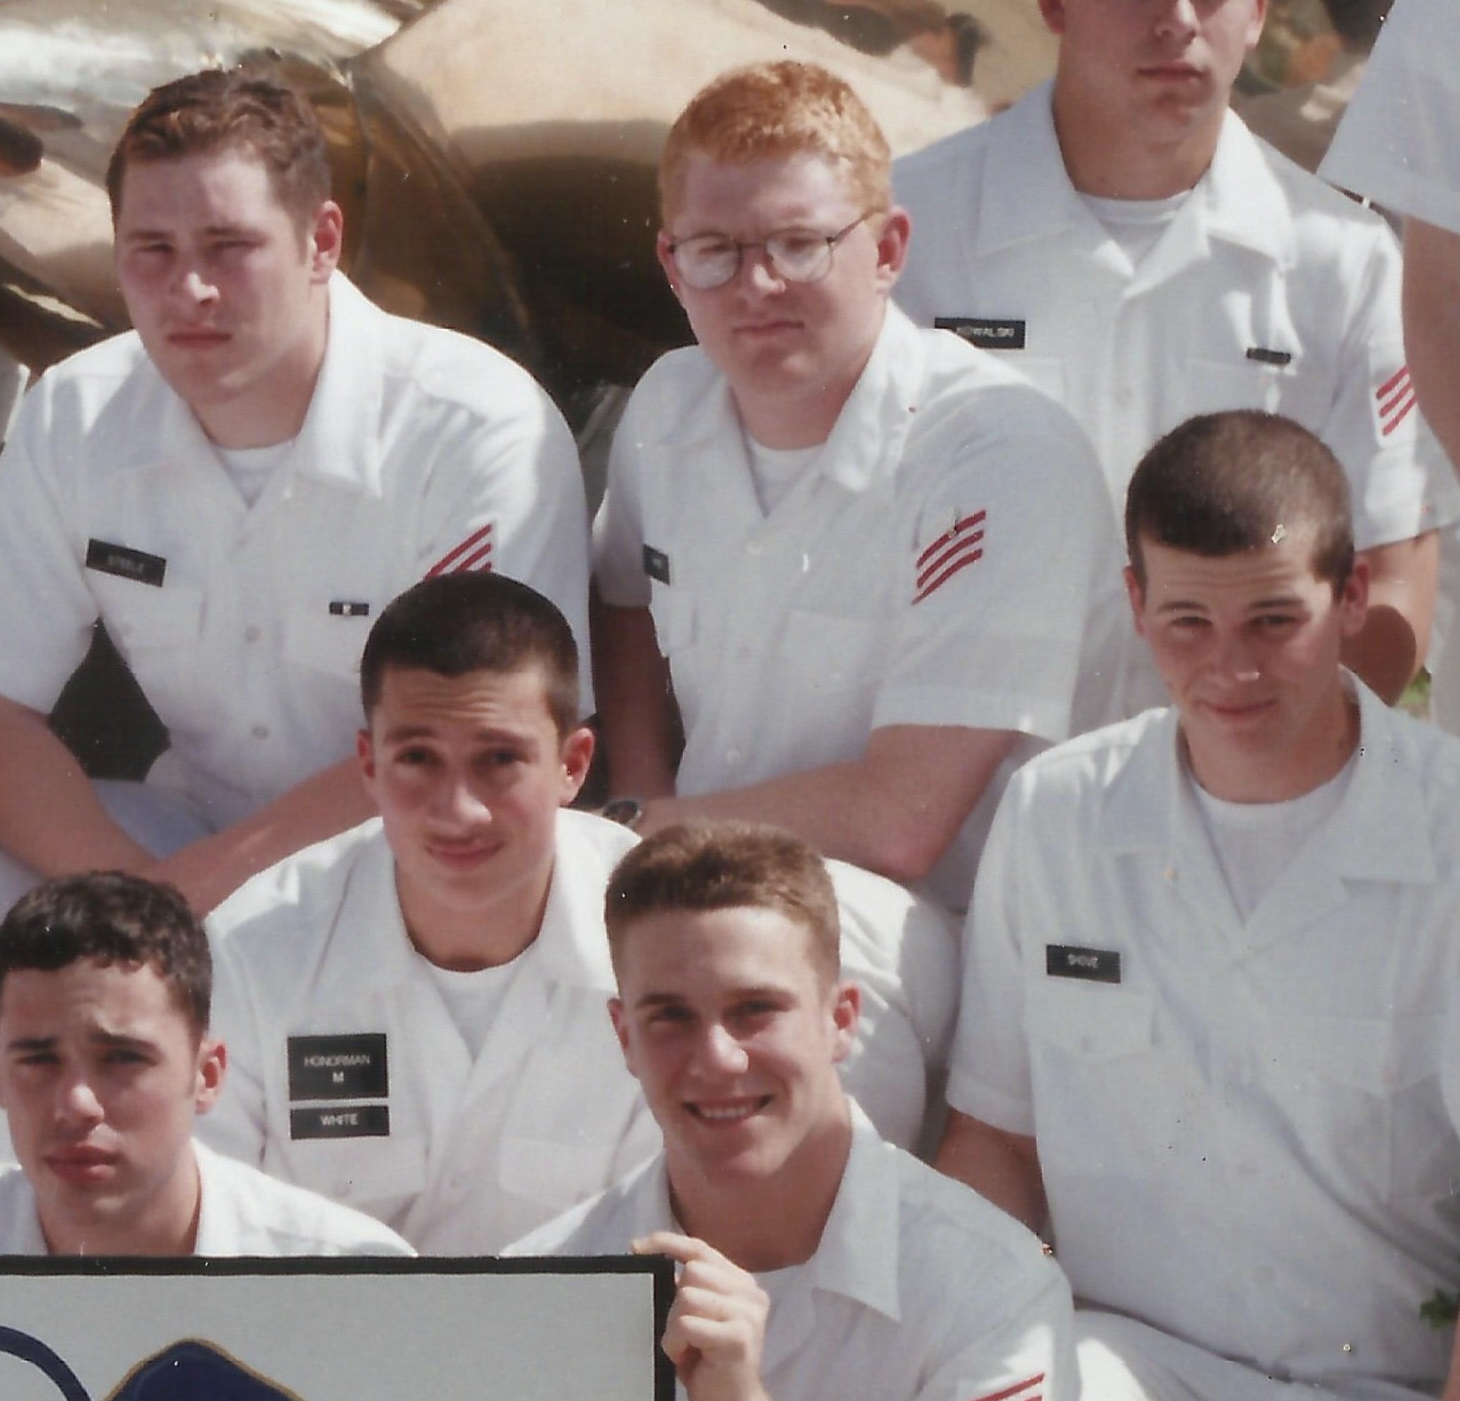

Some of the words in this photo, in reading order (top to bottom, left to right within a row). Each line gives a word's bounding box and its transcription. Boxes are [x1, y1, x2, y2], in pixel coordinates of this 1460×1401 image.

[305, 1055, 371, 1067] HONORMAN
[333, 1072, 345, 1084] M
[320, 1113, 359, 1126] WHITE
